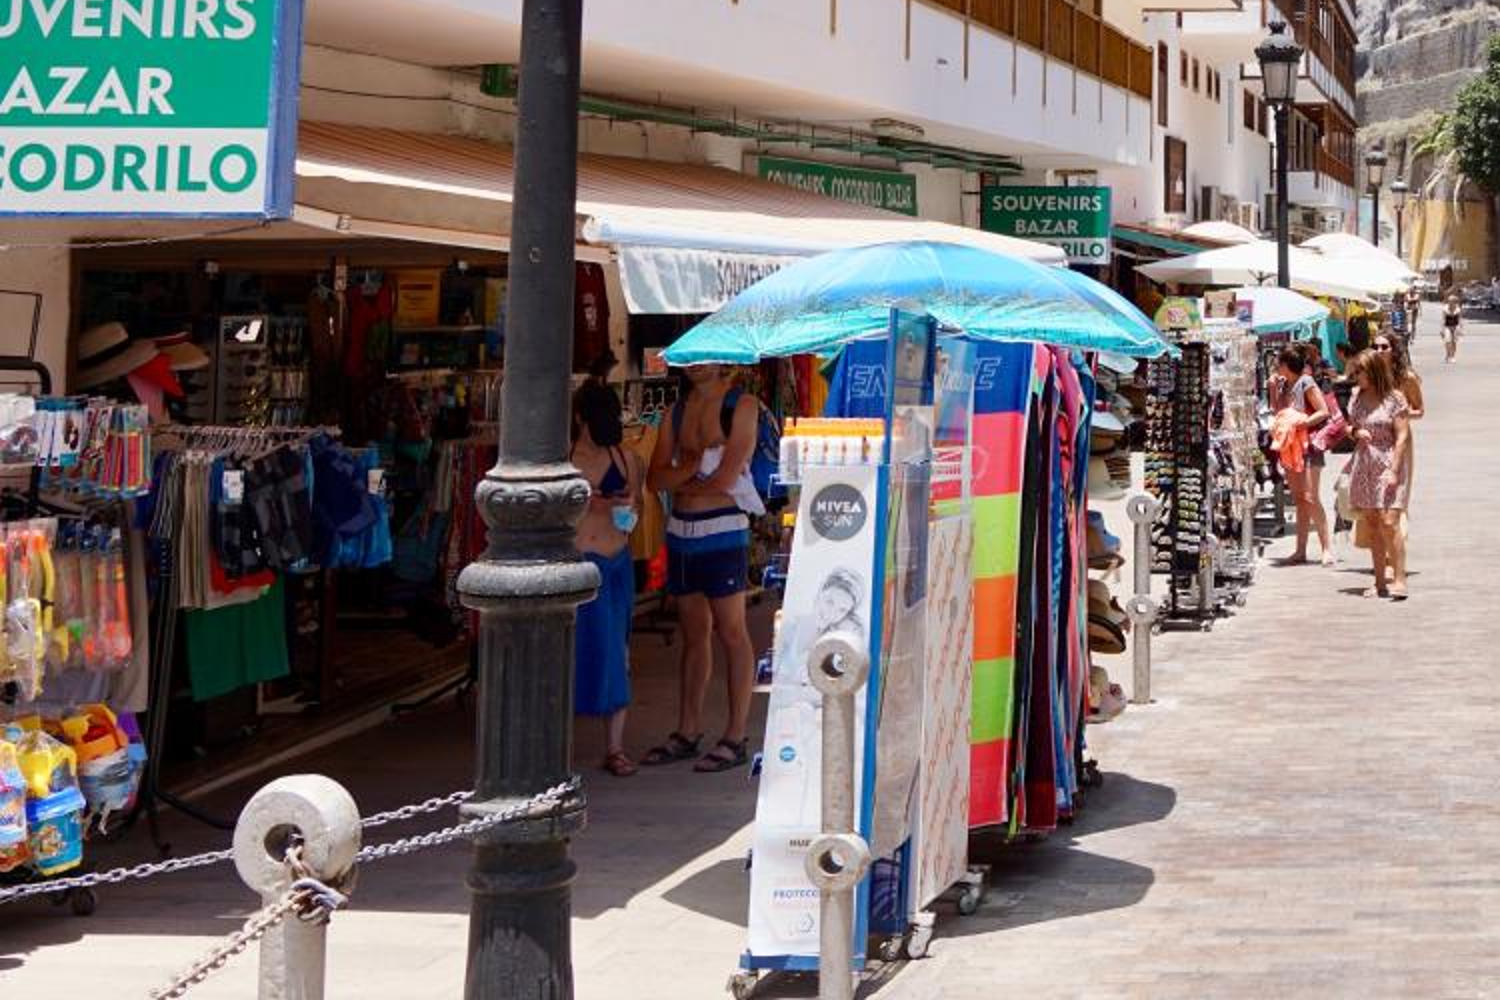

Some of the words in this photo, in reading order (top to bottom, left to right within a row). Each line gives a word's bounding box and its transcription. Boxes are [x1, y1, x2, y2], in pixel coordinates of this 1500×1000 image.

[0, 65, 175, 115] AZAR
[0, 143, 257, 193] ODRILO
[992, 195, 1102, 211] SOUVENIRS
[1015, 219, 1079, 235] BAZAR
[817, 501, 861, 512] NIVEA
[824, 515, 852, 527] SUN
